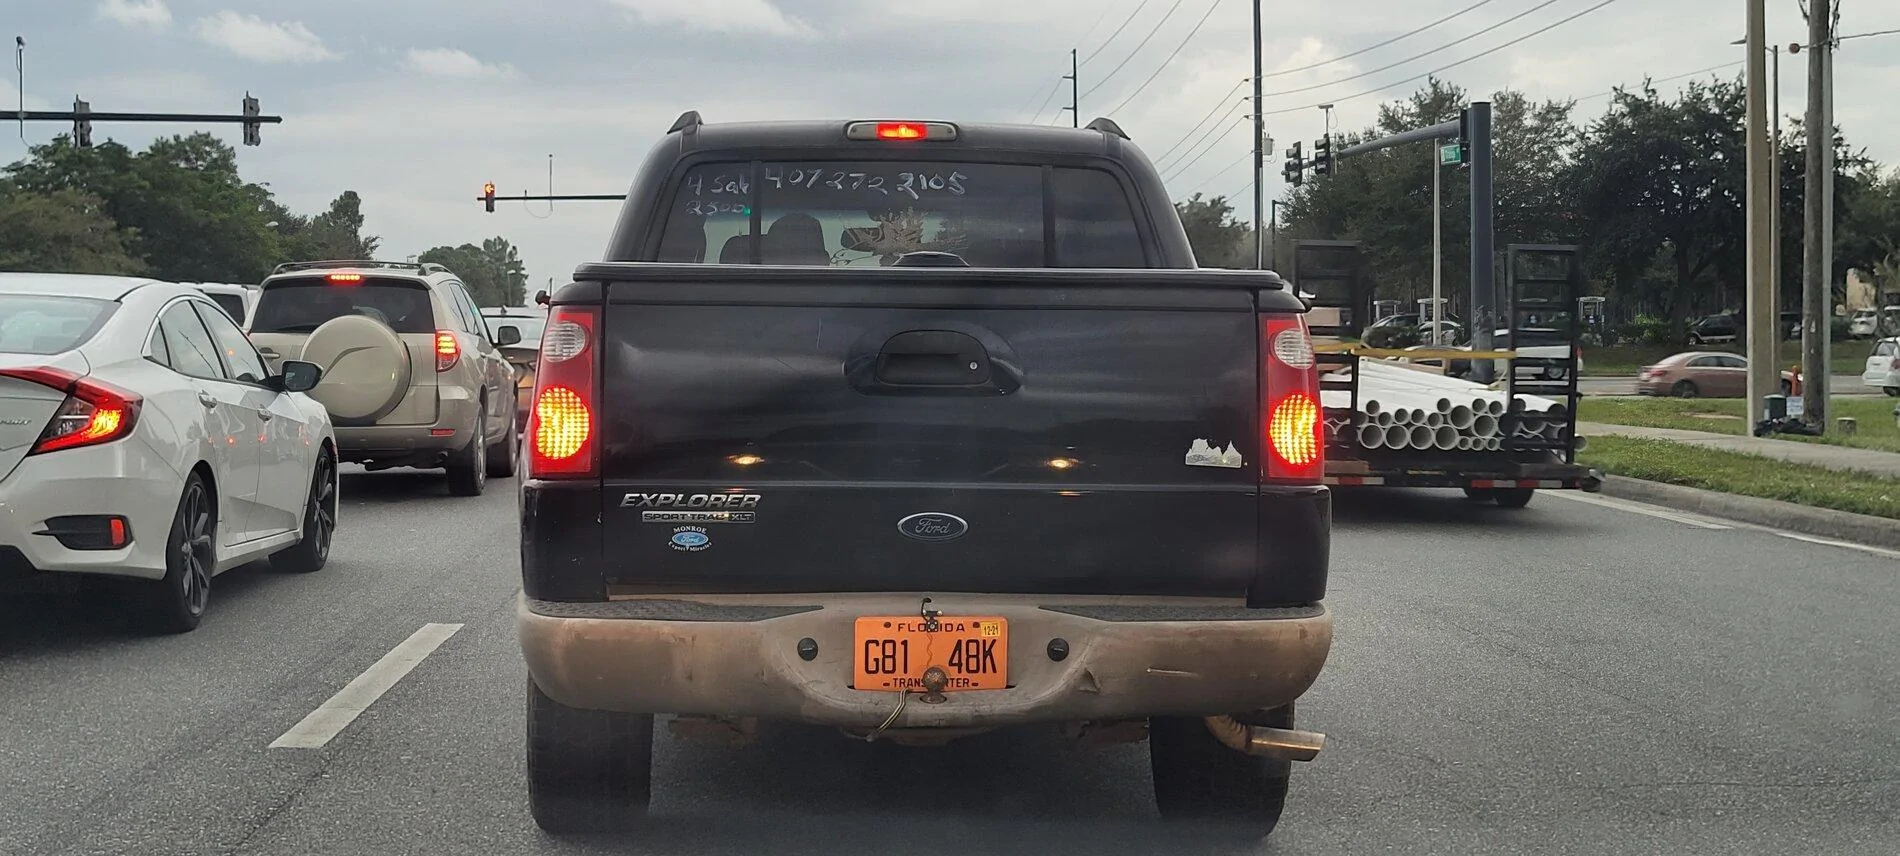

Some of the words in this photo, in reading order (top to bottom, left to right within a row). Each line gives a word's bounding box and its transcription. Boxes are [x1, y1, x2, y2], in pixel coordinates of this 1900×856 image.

[764, 167, 823, 189] 407
[825, 171, 888, 195] 272
[896, 171, 968, 200] 2105
[619, 493, 762, 508] EXPLORER
[644, 513, 688, 521] SPORT
[689, 512, 727, 521] TRAC
[730, 513, 752, 521] XLT
[673, 525, 707, 534] MONROE
[915, 517, 951, 533] Ford
[680, 535, 701, 544] Ford
[897, 622, 966, 633] FLOIDA
[864, 639, 909, 674] G81
[948, 639, 998, 674] 48K
[892, 677, 971, 688] TRANSTER
